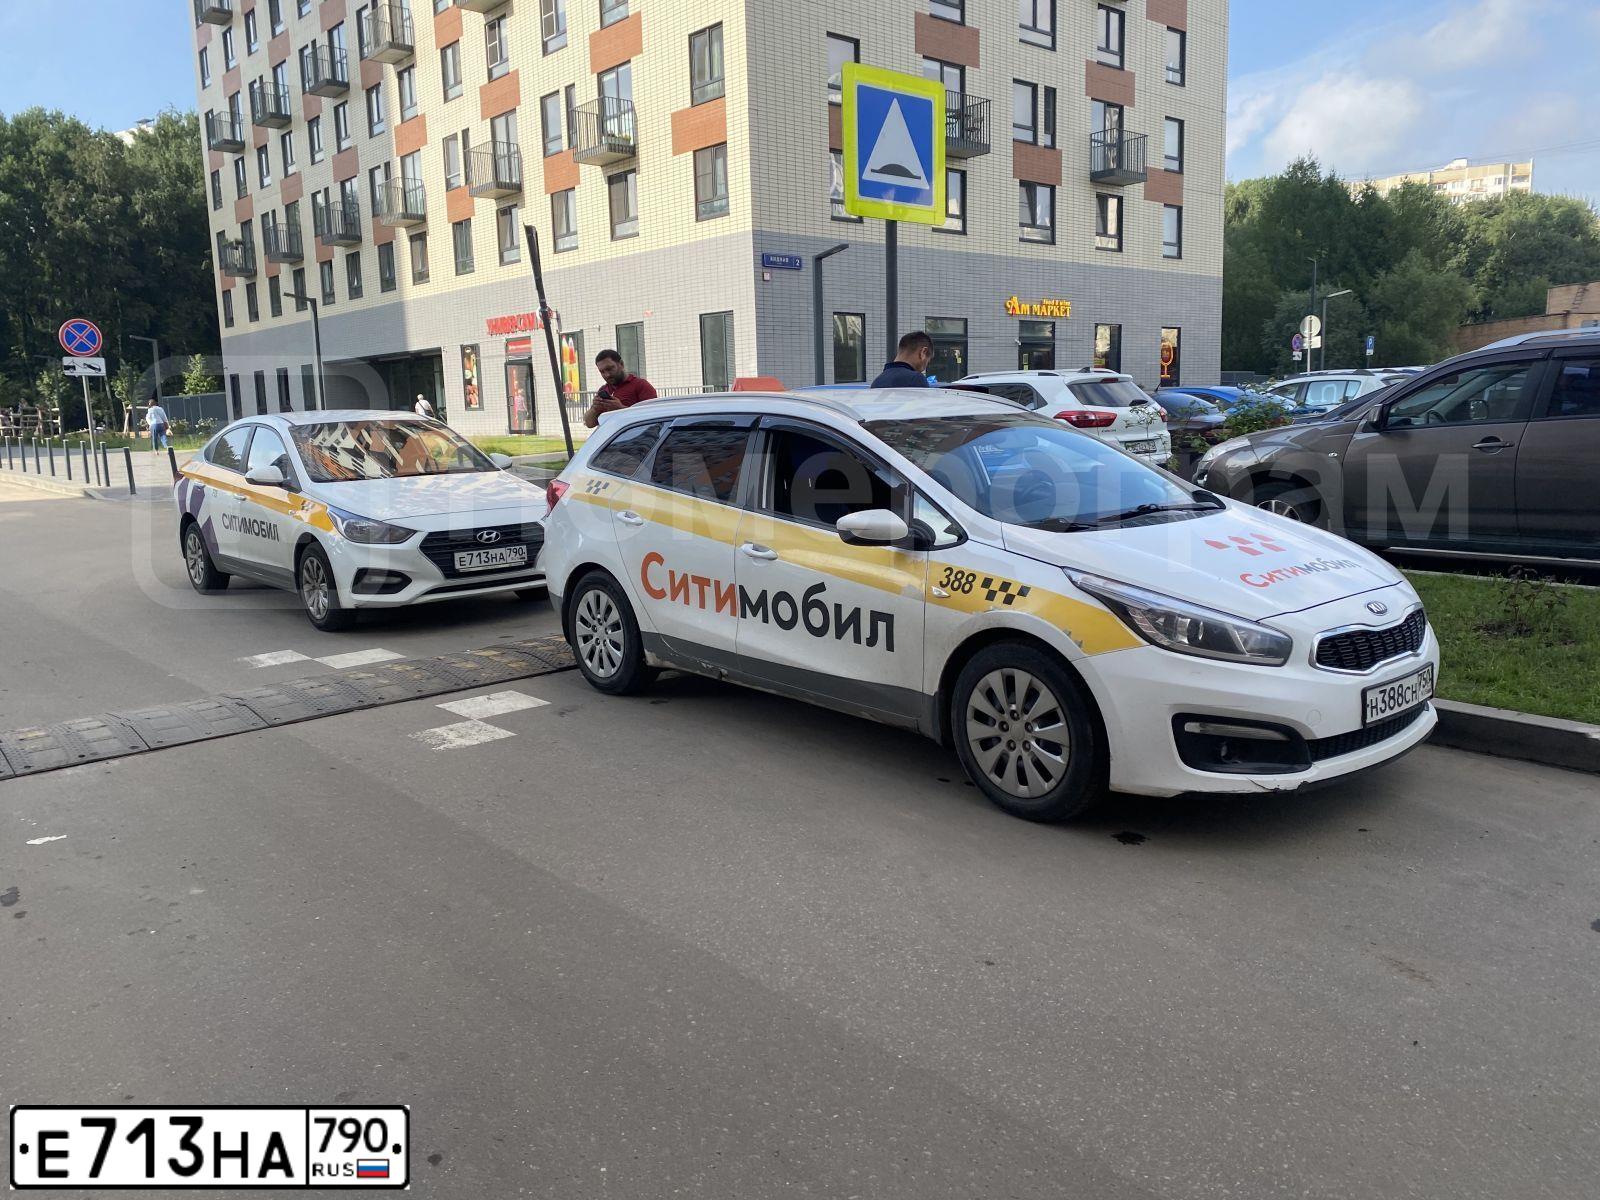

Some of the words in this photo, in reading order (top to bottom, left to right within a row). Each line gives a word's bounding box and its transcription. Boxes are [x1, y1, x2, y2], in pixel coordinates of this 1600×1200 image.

[1032, 304, 1072, 317] МАРКЕТ
[222, 512, 280, 542] СИТИМОБИЛ
[458, 551, 505, 567] Е713НА
[507, 547, 523, 558] 790
[938, 566, 977, 595] 388
[1239, 558, 1362, 588] Ситимобил
[641, 551, 896, 652] Ситимобил
[1370, 683, 1418, 718] Н388СН
